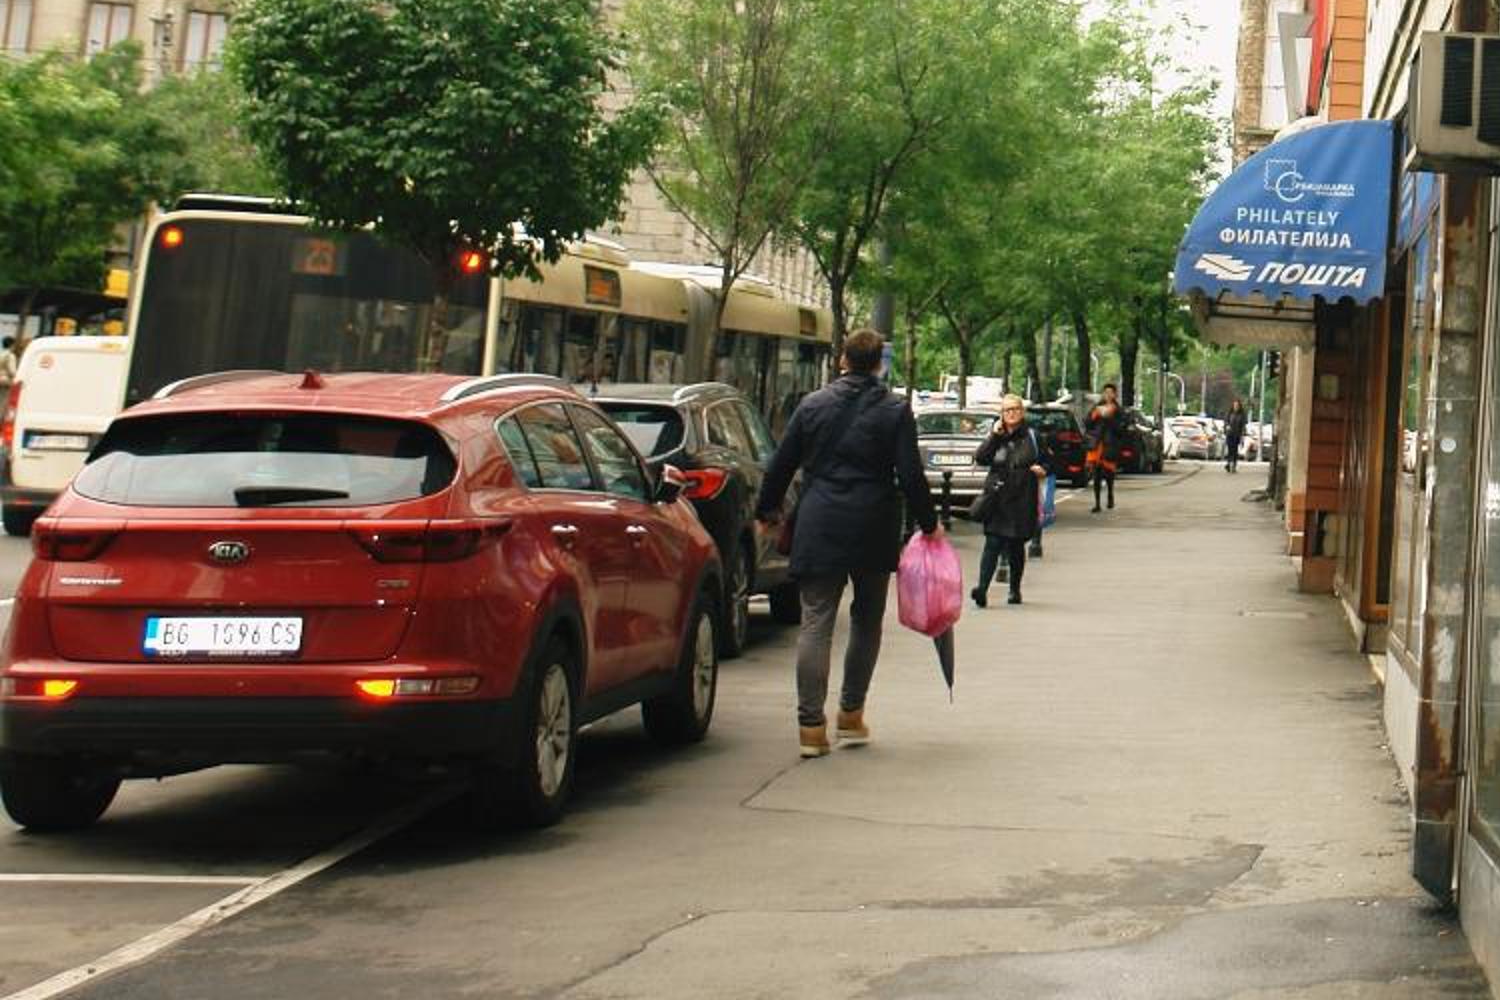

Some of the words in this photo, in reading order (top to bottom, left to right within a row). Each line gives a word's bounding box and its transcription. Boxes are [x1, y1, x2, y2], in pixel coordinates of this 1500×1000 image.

[1237, 207, 1340, 226] PHILATELY
[1220, 227, 1352, 249] ФИЛАТЕЛИЈА
[1256, 262, 1369, 288] ПОШТА
[214, 545, 240, 559] KIA
[163, 623, 189, 645] BG
